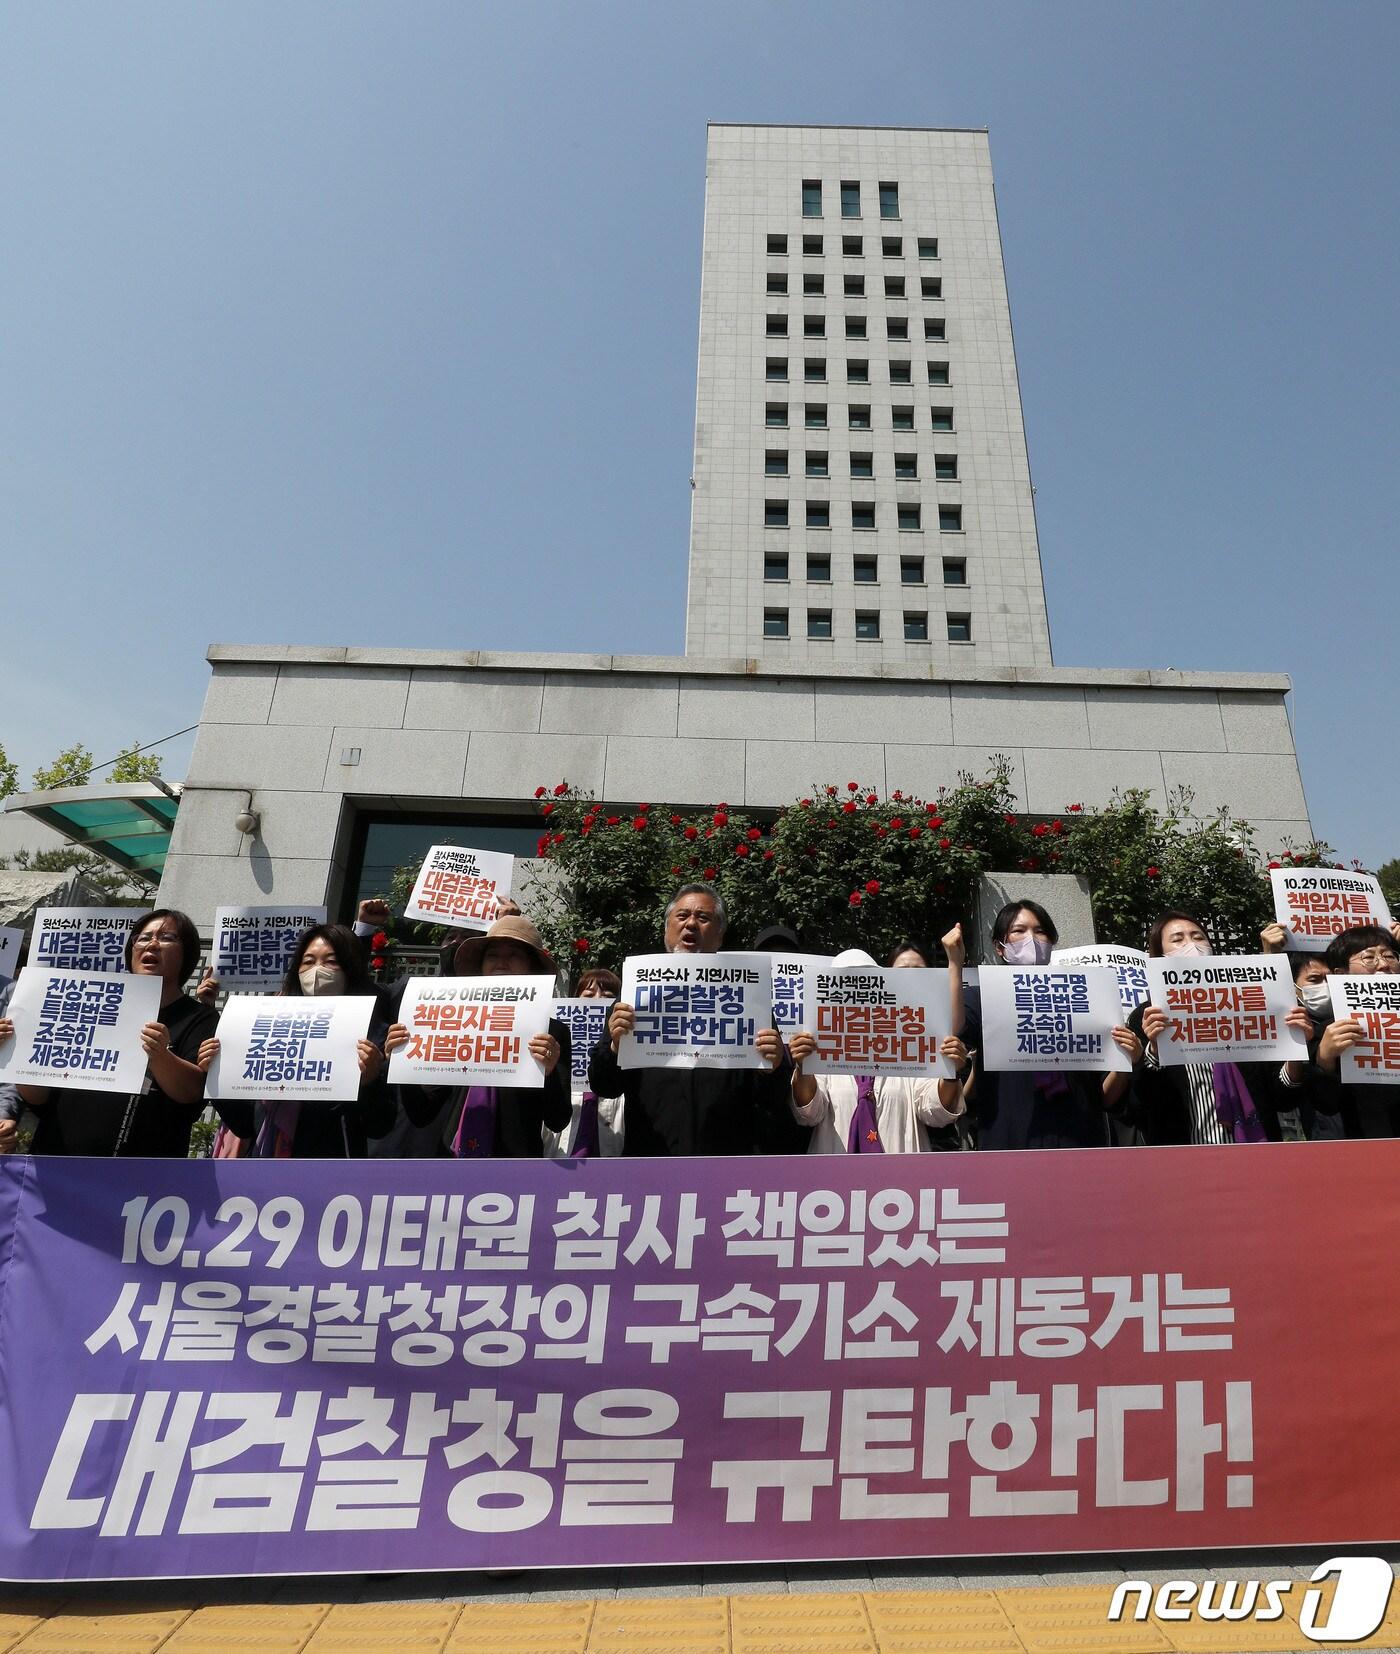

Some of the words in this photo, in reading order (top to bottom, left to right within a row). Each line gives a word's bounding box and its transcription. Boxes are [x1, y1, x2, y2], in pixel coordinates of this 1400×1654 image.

[430, 860, 480, 876] 구속거부하는
[434, 851, 476, 864] 참사책임자
[424, 871, 496, 899] 대검찰청
[1284, 878, 1317, 889] 10.29
[1320, 878, 1374, 894] 이태원참사
[418, 890, 497, 920] 규탄한다!
[1287, 892, 1370, 913] 책임자를
[42, 918, 82, 929] 윗선수사
[221, 917, 260, 928] 윗선수사
[38, 931, 125, 954] 대검찰청
[636, 968, 689, 982] 윗선수사
[695, 968, 759, 983] 지연시키는
[816, 974, 885, 990] 참사책임자
[1013, 974, 1088, 993] 진상규명
[1162, 969, 1201, 984] 10.29
[1205, 967, 1277, 984] 이태원참사
[46, 978, 124, 1004] 진상규명
[418, 987, 457, 1001] 10.29
[460, 987, 536, 1001] 이태원참사
[635, 985, 744, 1015] 대검찰청
[816, 989, 896, 1005] 구속거부하는
[1166, 985, 1267, 1014] 책임자를
[39, 998, 120, 1026] 특별법을
[1015, 993, 1090, 1013] 특별법을
[251, 1019, 330, 1038] 특별법을
[413, 1004, 515, 1031] 책임자를
[817, 1006, 926, 1034] 대검찰청
[1016, 1013, 1072, 1033] 조속히
[33, 1021, 95, 1046] 조속히
[633, 1016, 754, 1046] 규탄한다!
[1170, 1015, 1277, 1043] 처벌하라!
[245, 1039, 306, 1059] 조속히
[406, 1034, 520, 1063] 처벌하라!
[817, 1035, 936, 1063] 규탄한다!
[1017, 1034, 1102, 1054] 제정하라!
[28, 1044, 120, 1071] 제정하라!
[242, 1059, 332, 1081] 제정하라!
[120, 1196, 303, 1269] 10.29
[318, 1193, 535, 1270] 이태원
[552, 1191, 705, 1270] 참사
[720, 1188, 1009, 1268] 책임있는
[85, 1281, 610, 1367] 서울경찰청장의
[625, 1280, 919, 1363] 구속기소
[937, 1272, 1235, 1358] 제동거는
[29, 1386, 684, 1537] 대검찰청을
[710, 1380, 1254, 1522] 규탄한다!
